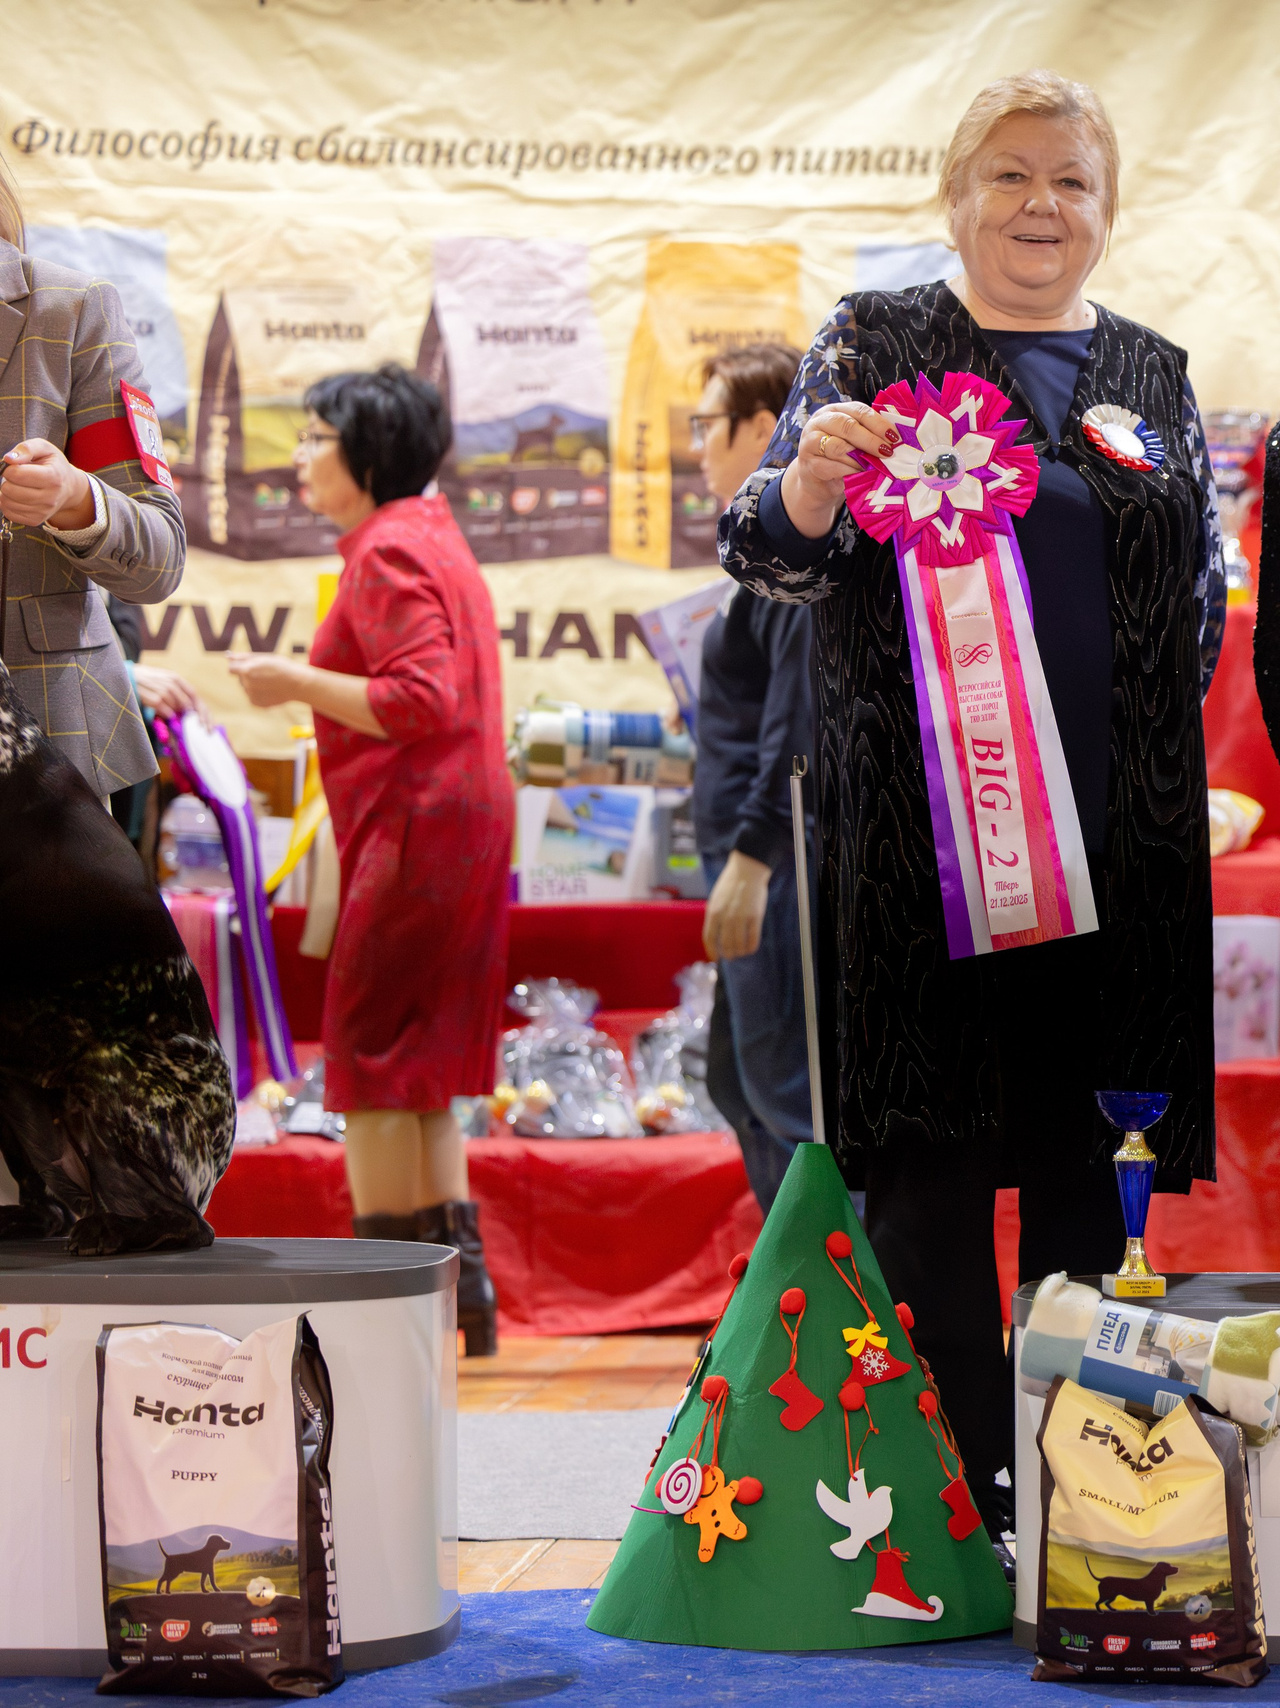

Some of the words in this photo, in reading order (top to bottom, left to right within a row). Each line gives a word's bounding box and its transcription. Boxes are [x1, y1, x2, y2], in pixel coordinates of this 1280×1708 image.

[12, 116, 280, 172] Философия
[292, 122, 761, 178] сбалансированного
[477, 322, 579, 346] Hanta
[958, 680, 1002, 693] ВСЕРОССИЙСКАЯ
[959, 692, 986, 704] ВЫСТАВКА
[986, 691, 1003, 701] СОБАК
[966, 704, 980, 713] ВСЕХ
[981, 702, 999, 711] ПОРОД
[971, 735, 1012, 812] BIG
[987, 849, 1019, 868] 2
[994, 881, 1019, 895] Тверь
[990, 894, 1029, 909] 21.12.2025
[1096, 1311, 1122, 1351] ПЛЕД
[162, 1352, 181, 1362] Корм
[182, 1358, 202, 1367] сухой
[167, 1373, 173, 1381] с
[133, 1395, 265, 1427] Hanta
[172, 1427, 225, 1440] premium
[171, 1469, 218, 1482] PUPPY
[319, 1486, 342, 1657] Hanta
[166, 1623, 185, 1631] FRESH
[166, 1630, 182, 1638] MEAT
[1107, 1637, 1126, 1645] FRESH
